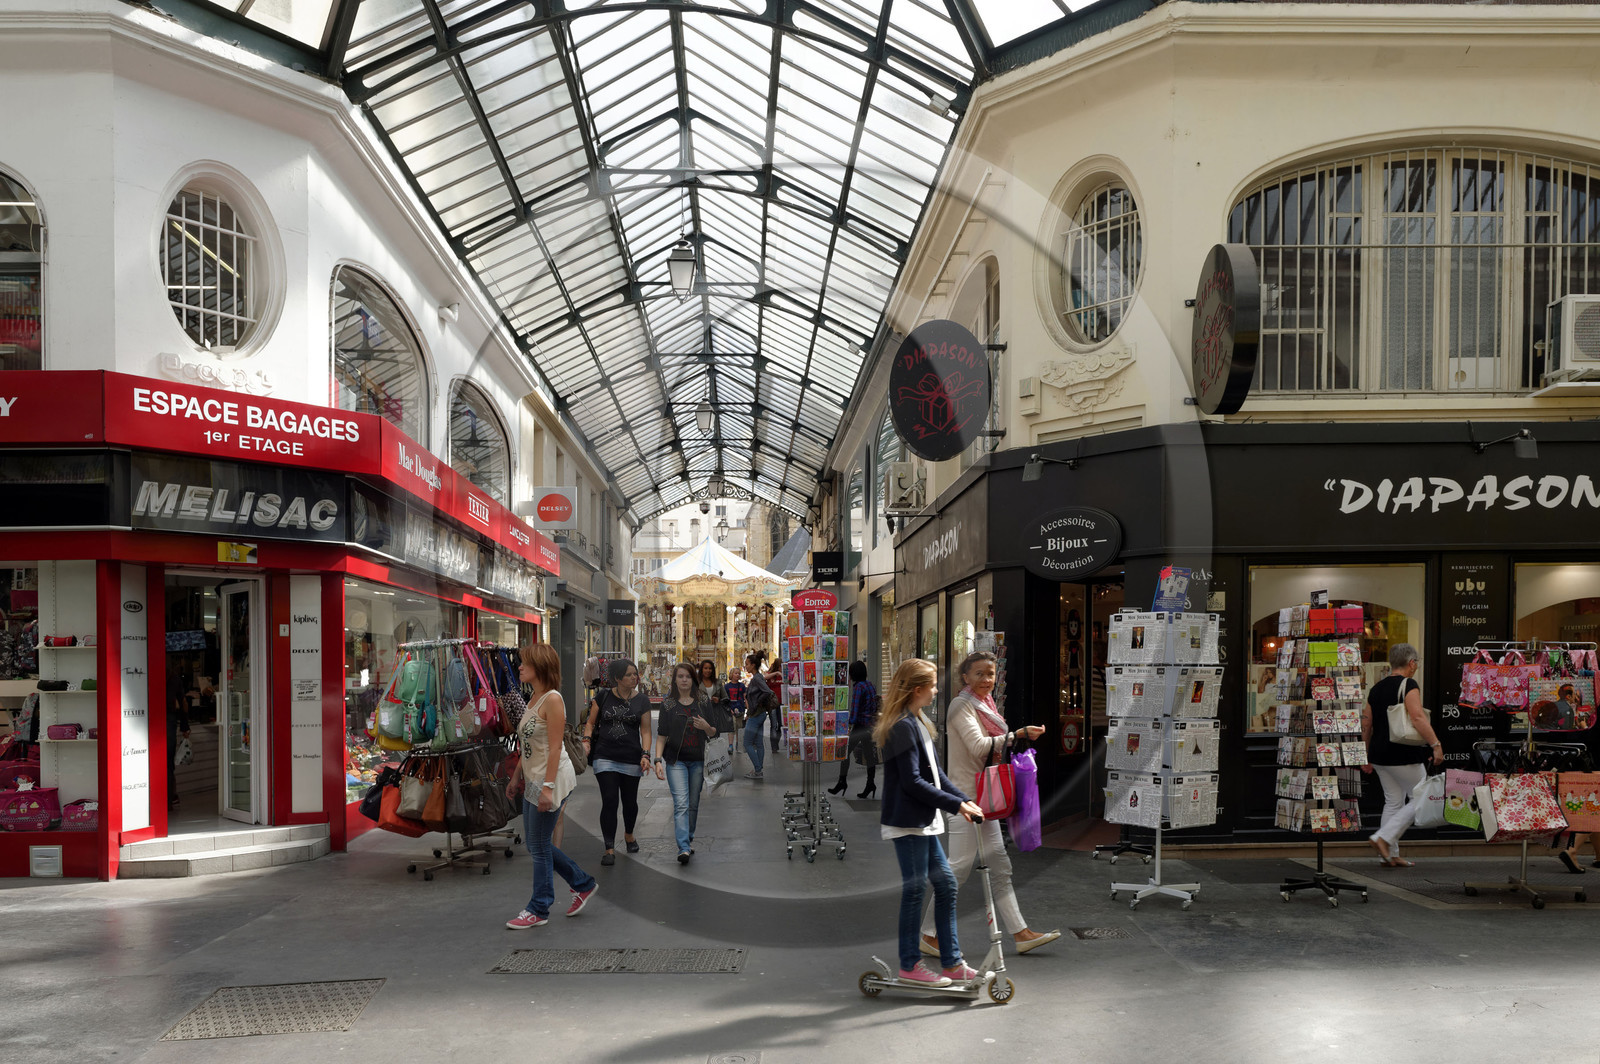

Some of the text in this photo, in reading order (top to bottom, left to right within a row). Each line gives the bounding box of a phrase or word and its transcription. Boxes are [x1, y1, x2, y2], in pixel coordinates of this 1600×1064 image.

[897, 341, 984, 370] "DIAPASON"
[133, 388, 360, 442] ESPACE BAGAGES
[204, 430, 304, 456] 1er ETAGE
[398, 442, 442, 492] Mac Douglas
[132, 481, 338, 532] MELISAC
[468, 496, 490, 522] TEXIER
[1039, 515, 1096, 536] Accessoires
[1046, 536, 1089, 553] Bijoux
[1041, 554, 1094, 570] Décoration
[1455, 578, 1486, 591] ubu
[805, 598, 830, 606] EDITOR
[293, 614, 318, 624] kipling
[1452, 616, 1486, 626] lollipops
[1447, 646, 1479, 655] KENZO
